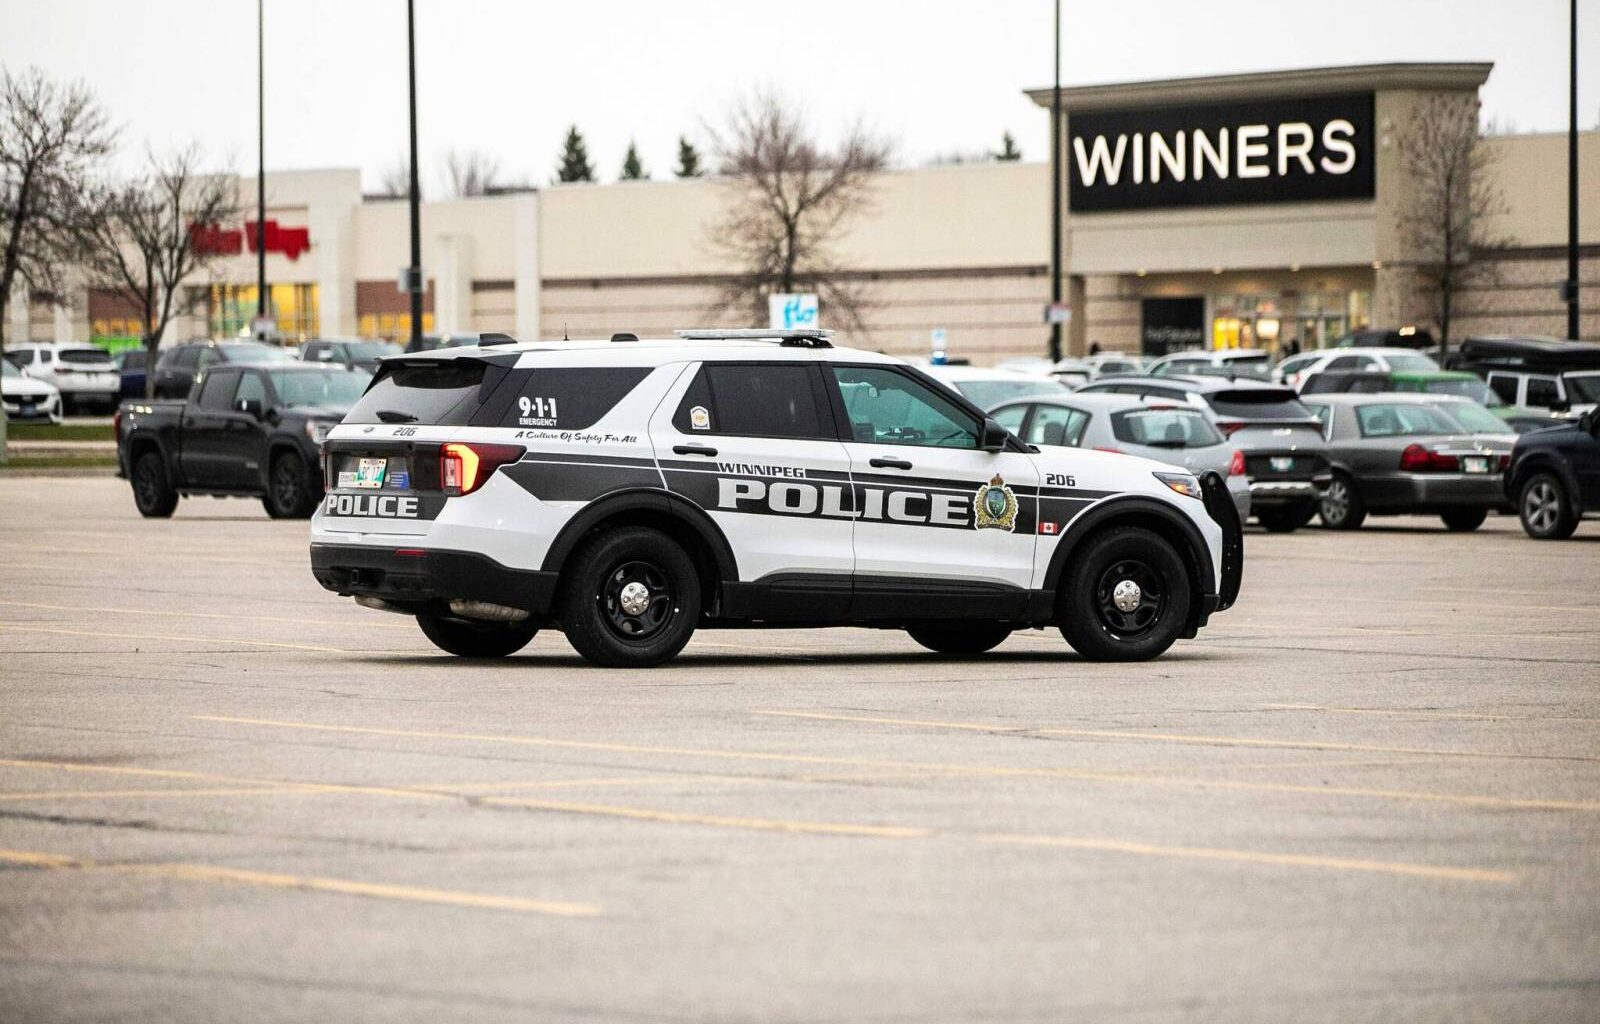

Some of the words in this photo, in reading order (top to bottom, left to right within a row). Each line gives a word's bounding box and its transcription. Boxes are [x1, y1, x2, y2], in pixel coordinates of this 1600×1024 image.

[1073, 118, 1356, 186] WINNERS
[519, 417, 557, 427] EMERGENCY
[392, 427, 418, 437] 206
[515, 430, 524, 439] A
[526, 431, 559, 439] Culture
[560, 432, 573, 442] Of
[574, 432, 603, 443] Safety
[604, 434, 620, 442] For
[621, 435, 638, 443] All
[719, 462, 804, 478] WINNIPEG
[1045, 473, 1076, 487] 206
[325, 494, 419, 518] POLICE
[717, 477, 970, 526] POLICE
